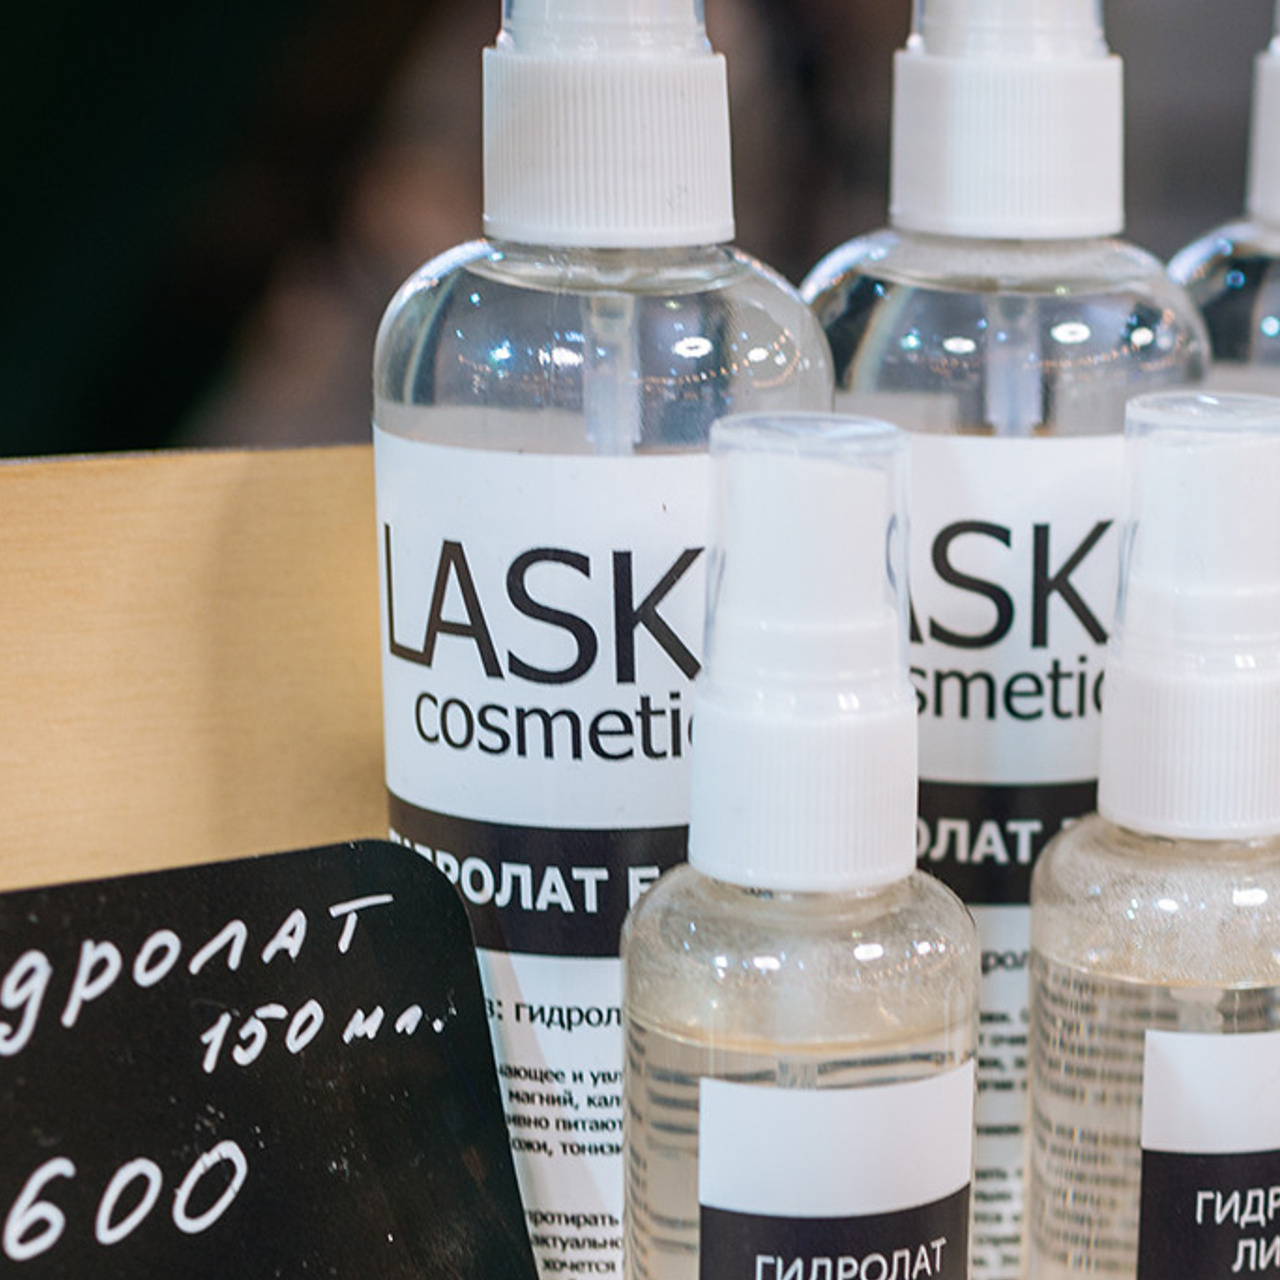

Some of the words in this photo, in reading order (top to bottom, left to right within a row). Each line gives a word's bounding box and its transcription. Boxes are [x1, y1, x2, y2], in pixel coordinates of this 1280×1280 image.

[384, 522, 706, 687] LASK
[413, 692, 697, 762] cosmeti
[201, 999, 325, 1074] 150
